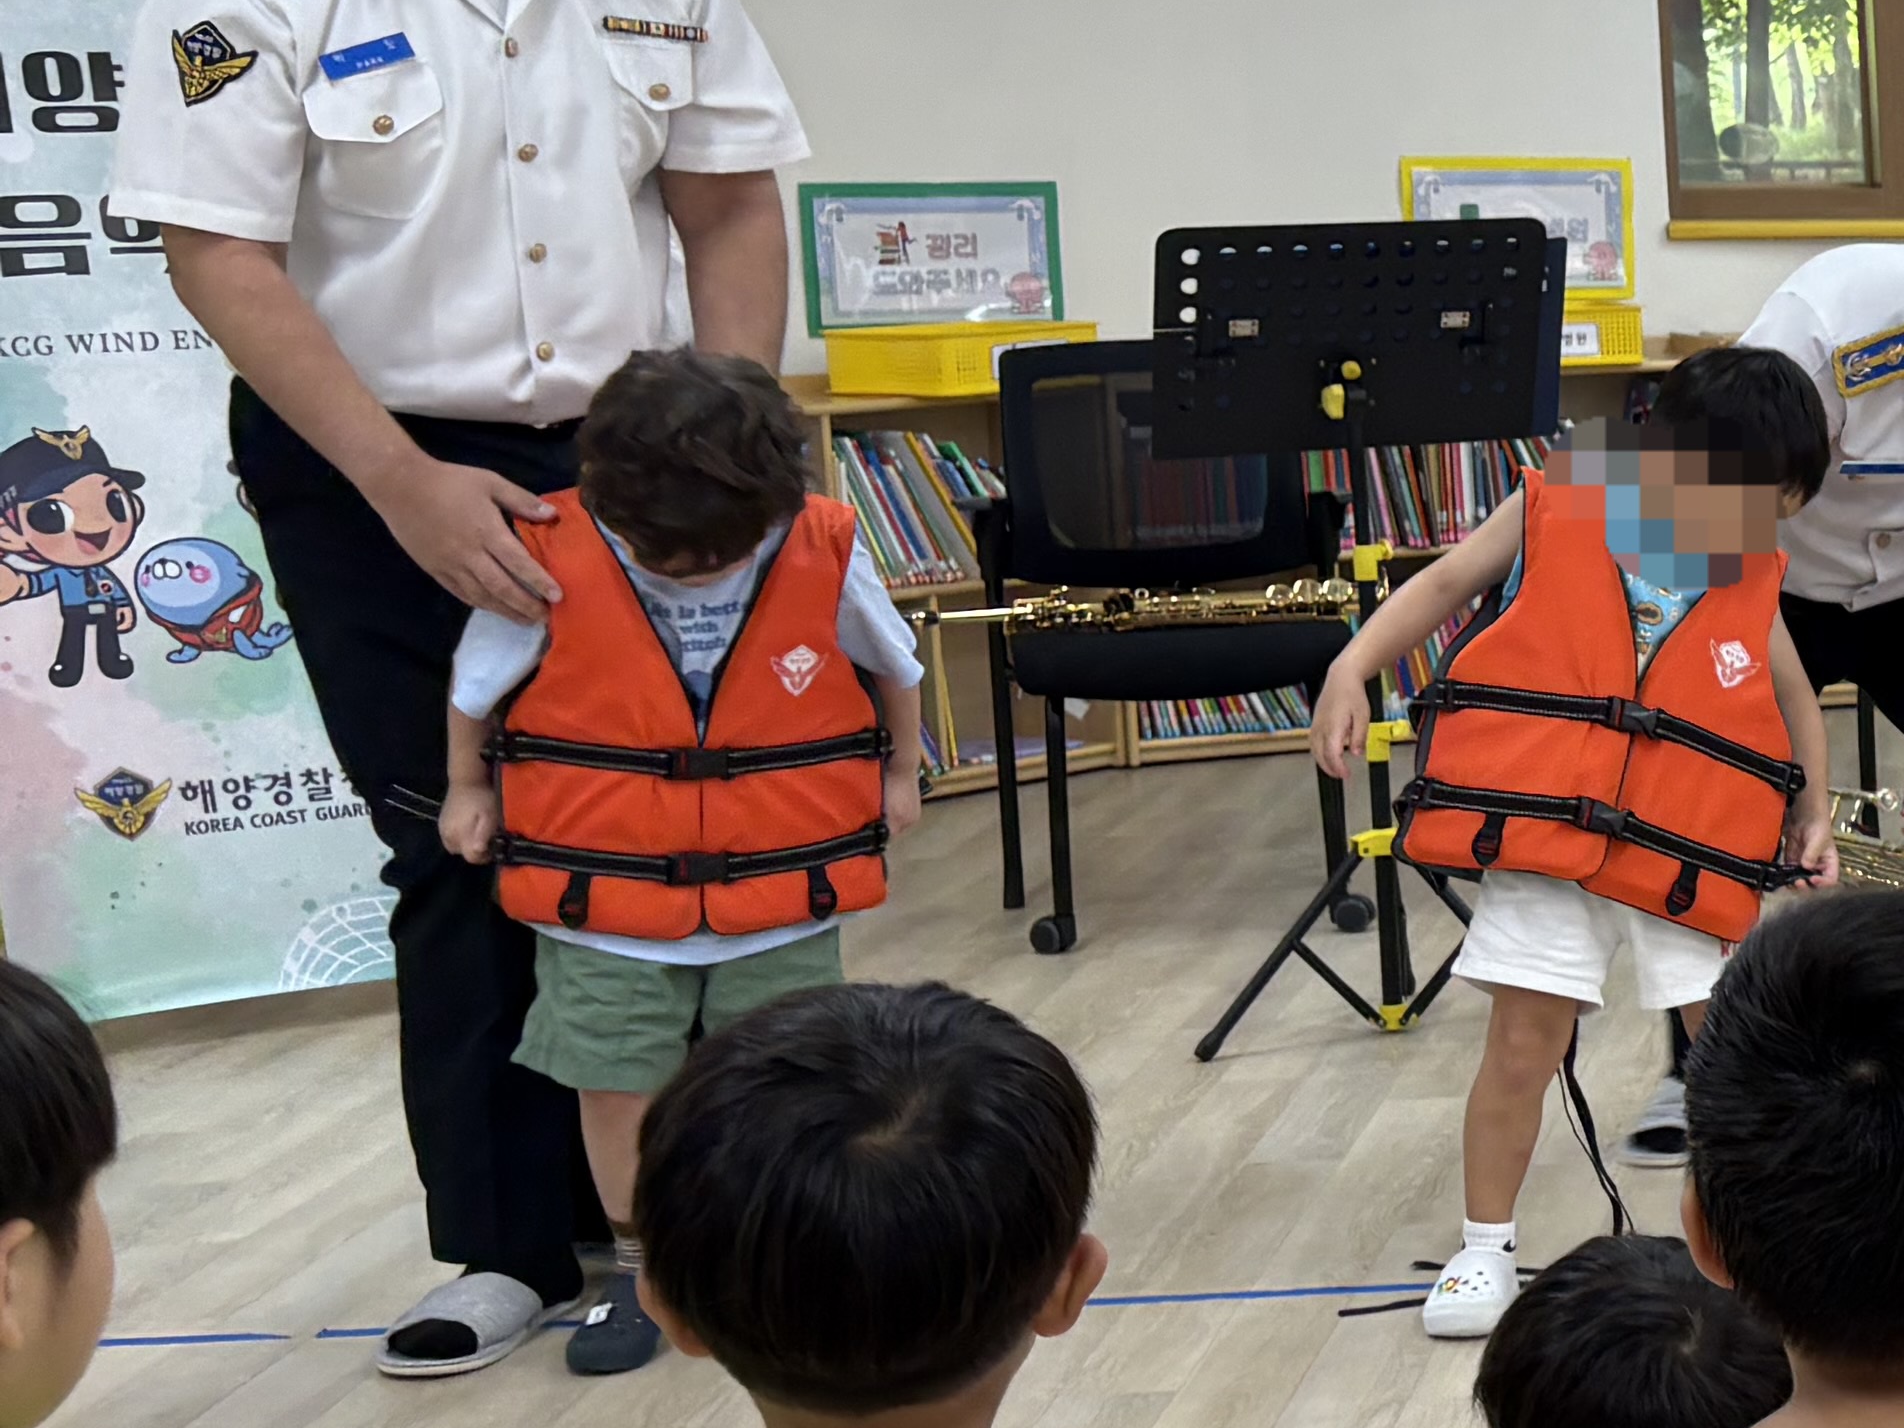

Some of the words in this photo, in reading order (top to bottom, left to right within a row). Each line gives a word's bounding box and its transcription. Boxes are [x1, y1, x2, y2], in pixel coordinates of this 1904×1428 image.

[0, 51, 125, 133] 양
[65, 331, 160, 354] WIND
[179, 767, 353, 815] 해양경찰
[185, 817, 244, 836] KOREA
[250, 809, 308, 829] COAST
